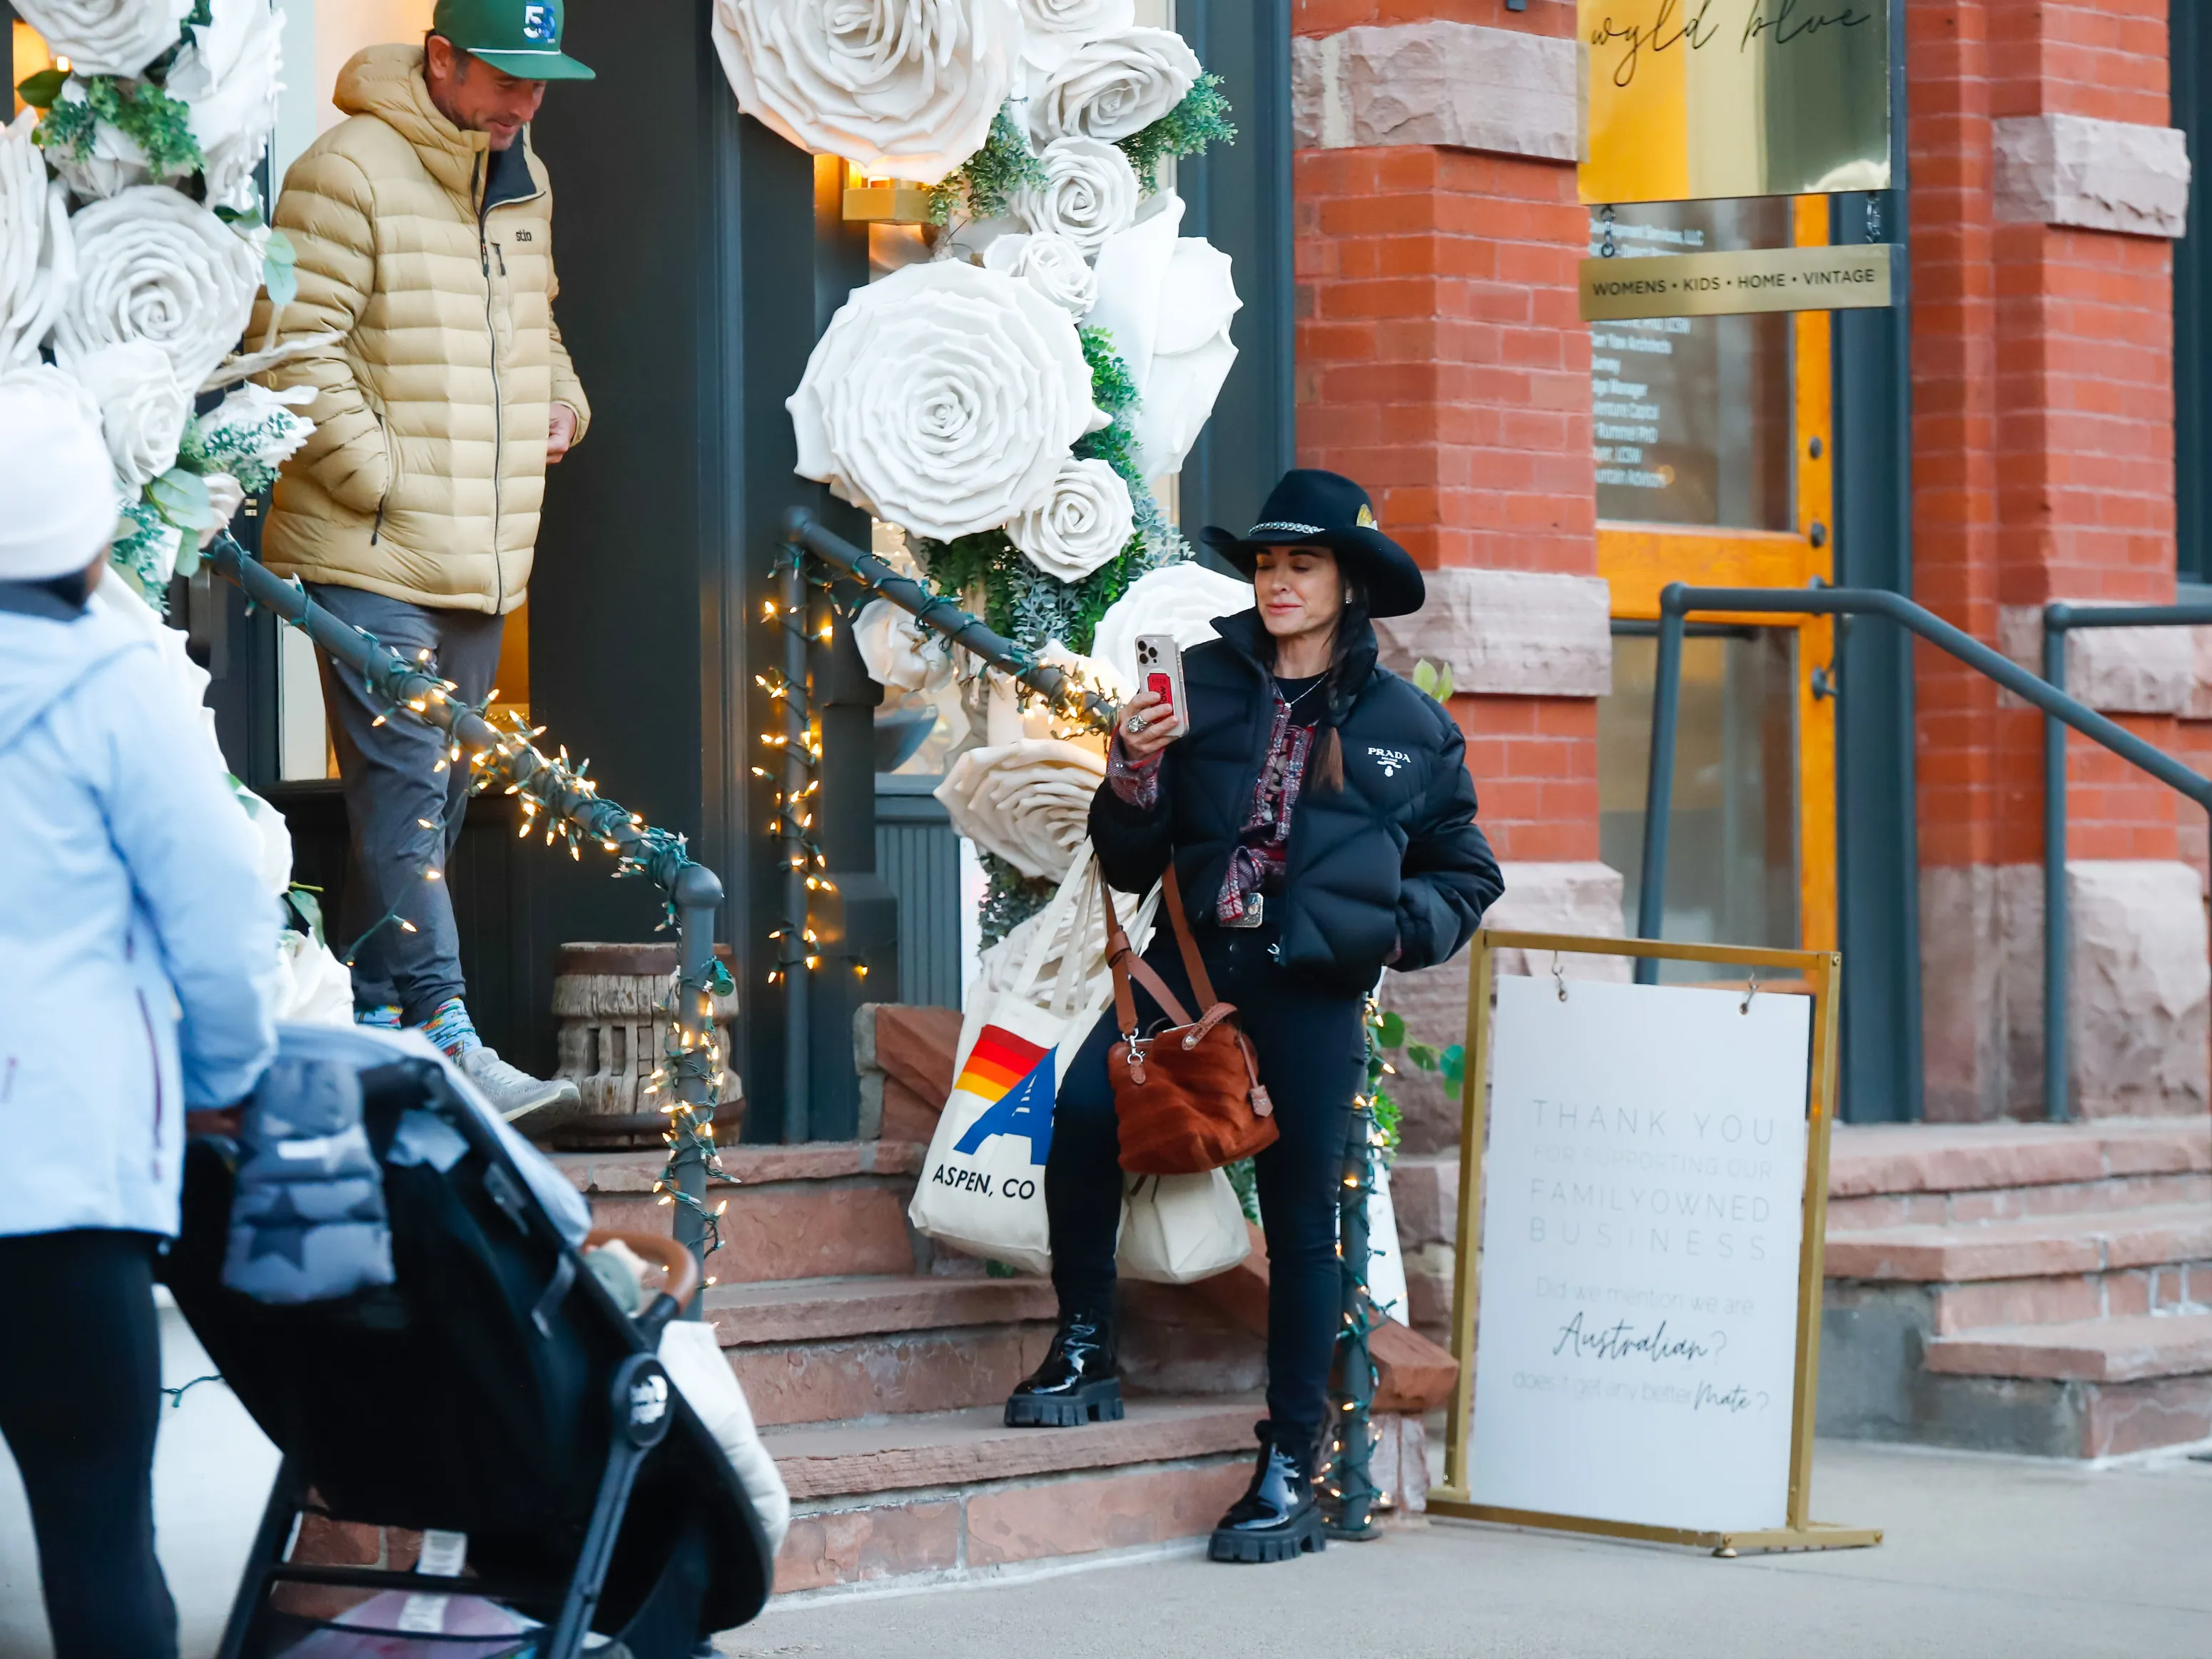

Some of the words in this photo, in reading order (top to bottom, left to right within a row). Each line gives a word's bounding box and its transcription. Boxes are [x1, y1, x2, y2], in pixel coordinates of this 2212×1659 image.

[1591, 0, 1720, 86] wyld
[1740, 0, 1871, 53] blue
[516, 229, 532, 241] stio
[1592, 280, 1667, 296] WOMENS
[1683, 277, 1720, 291] KIDS
[1737, 273, 1785, 288] HOME
[1802, 268, 1875, 285] VINTAGE
[1367, 747, 1411, 763] PRADA
[1532, 1099, 1666, 1137] THANK
[1693, 1111, 1774, 1145] YOU
[1533, 1144, 1574, 1165] FOR
[1582, 1146, 1719, 1176] SUPPORTING
[1726, 1157, 1772, 1179] OUR
[933, 1164, 993, 1197] ASPEN,
[1003, 1178, 1035, 1199] CO
[1530, 1177, 1770, 1223] FAMILYOWNED
[1529, 1216, 1767, 1261] BUSINESS
[1536, 1276, 1567, 1299] Did
[1573, 1284, 1600, 1302] we
[1605, 1287, 1683, 1311] mention
[1690, 1295, 1718, 1314] we
[1723, 1297, 1754, 1316] are
